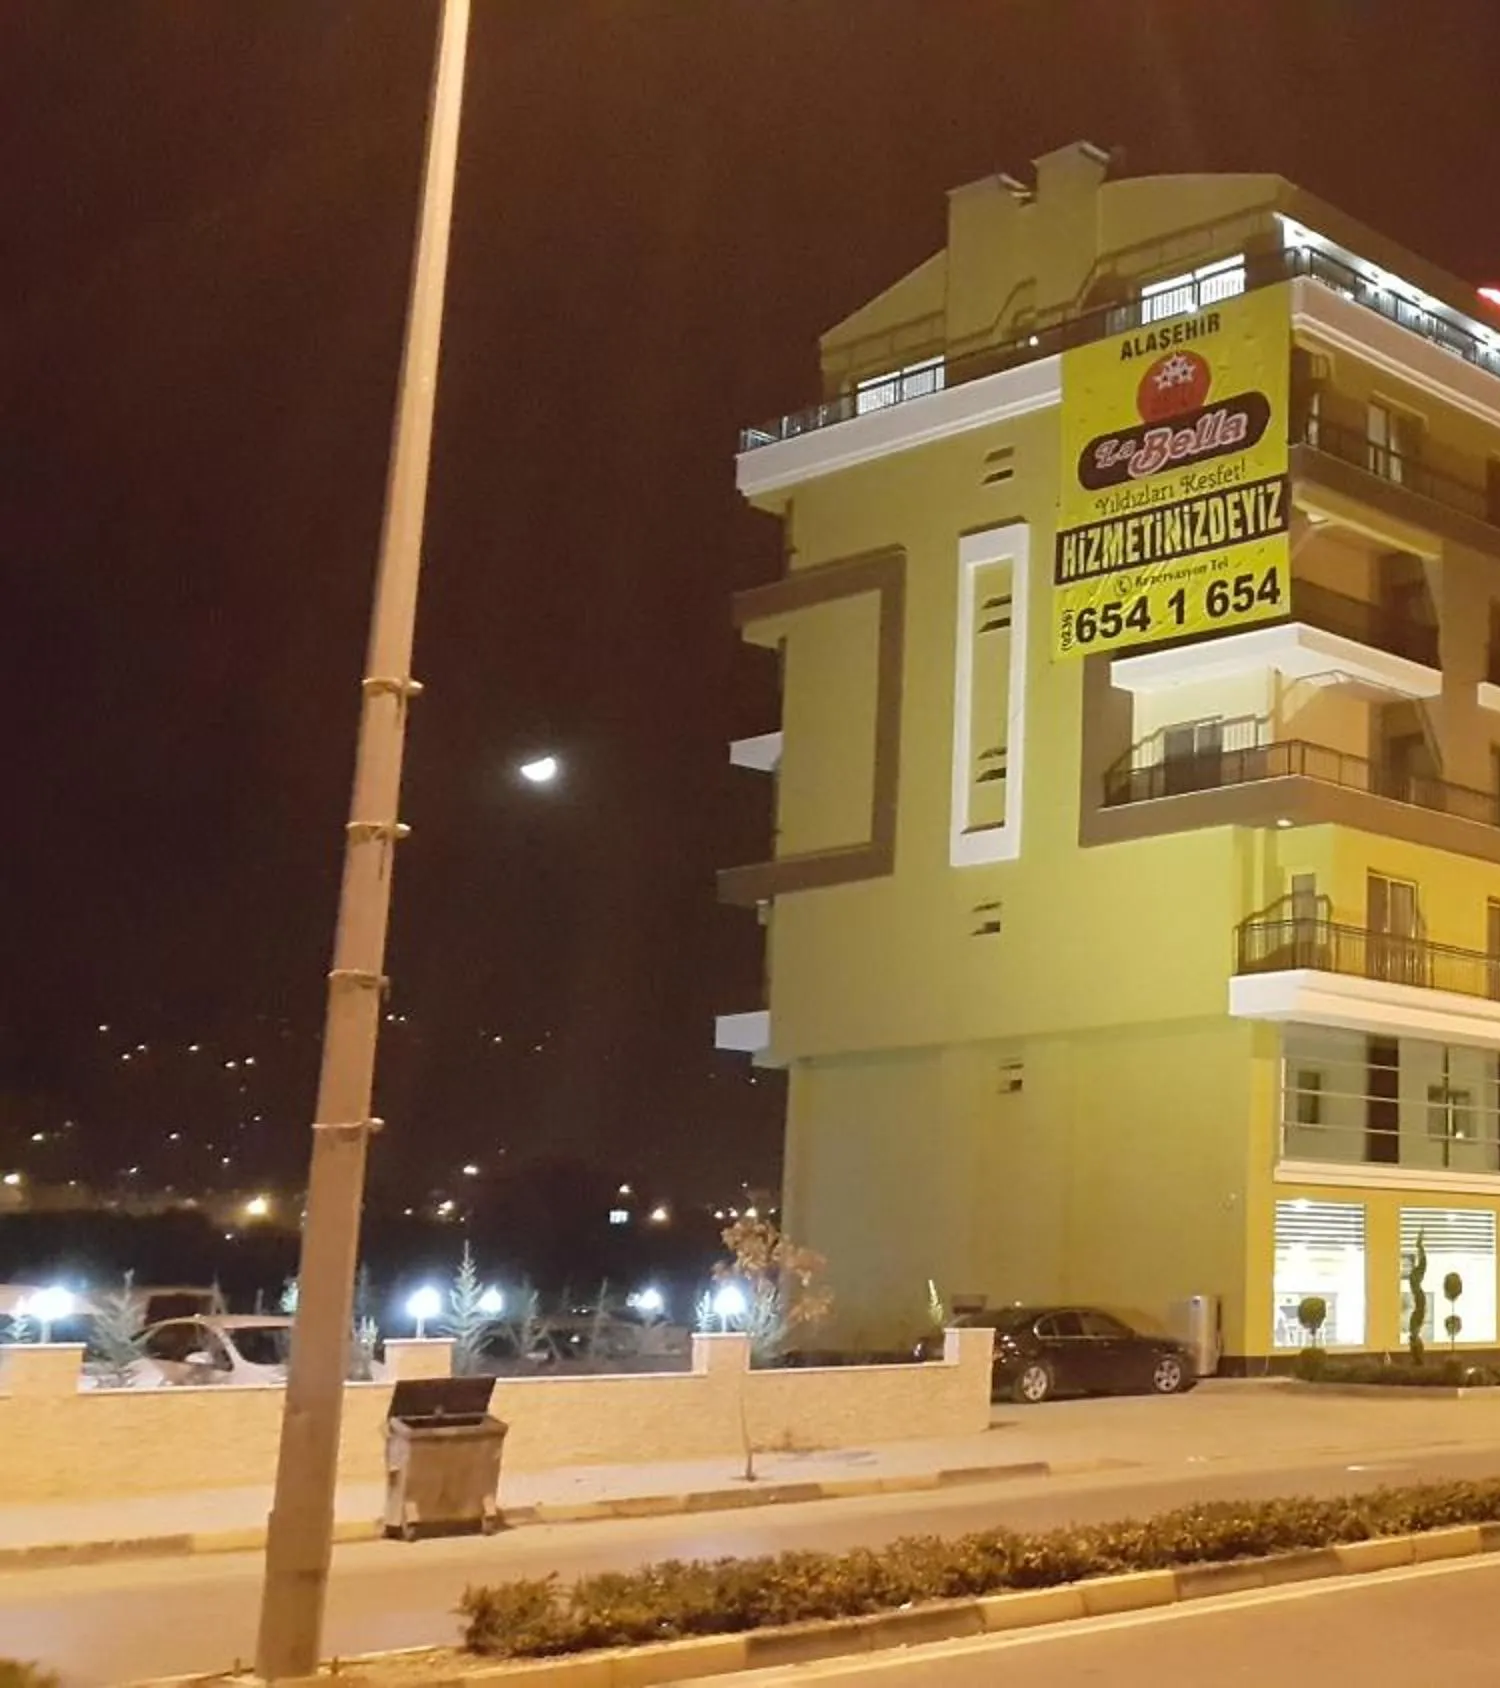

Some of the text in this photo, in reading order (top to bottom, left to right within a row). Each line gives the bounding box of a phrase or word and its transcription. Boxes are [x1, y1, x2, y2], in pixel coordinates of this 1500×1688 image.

[1128, 409, 1247, 478] Bella
[1075, 566, 1281, 643] 654 1 654
